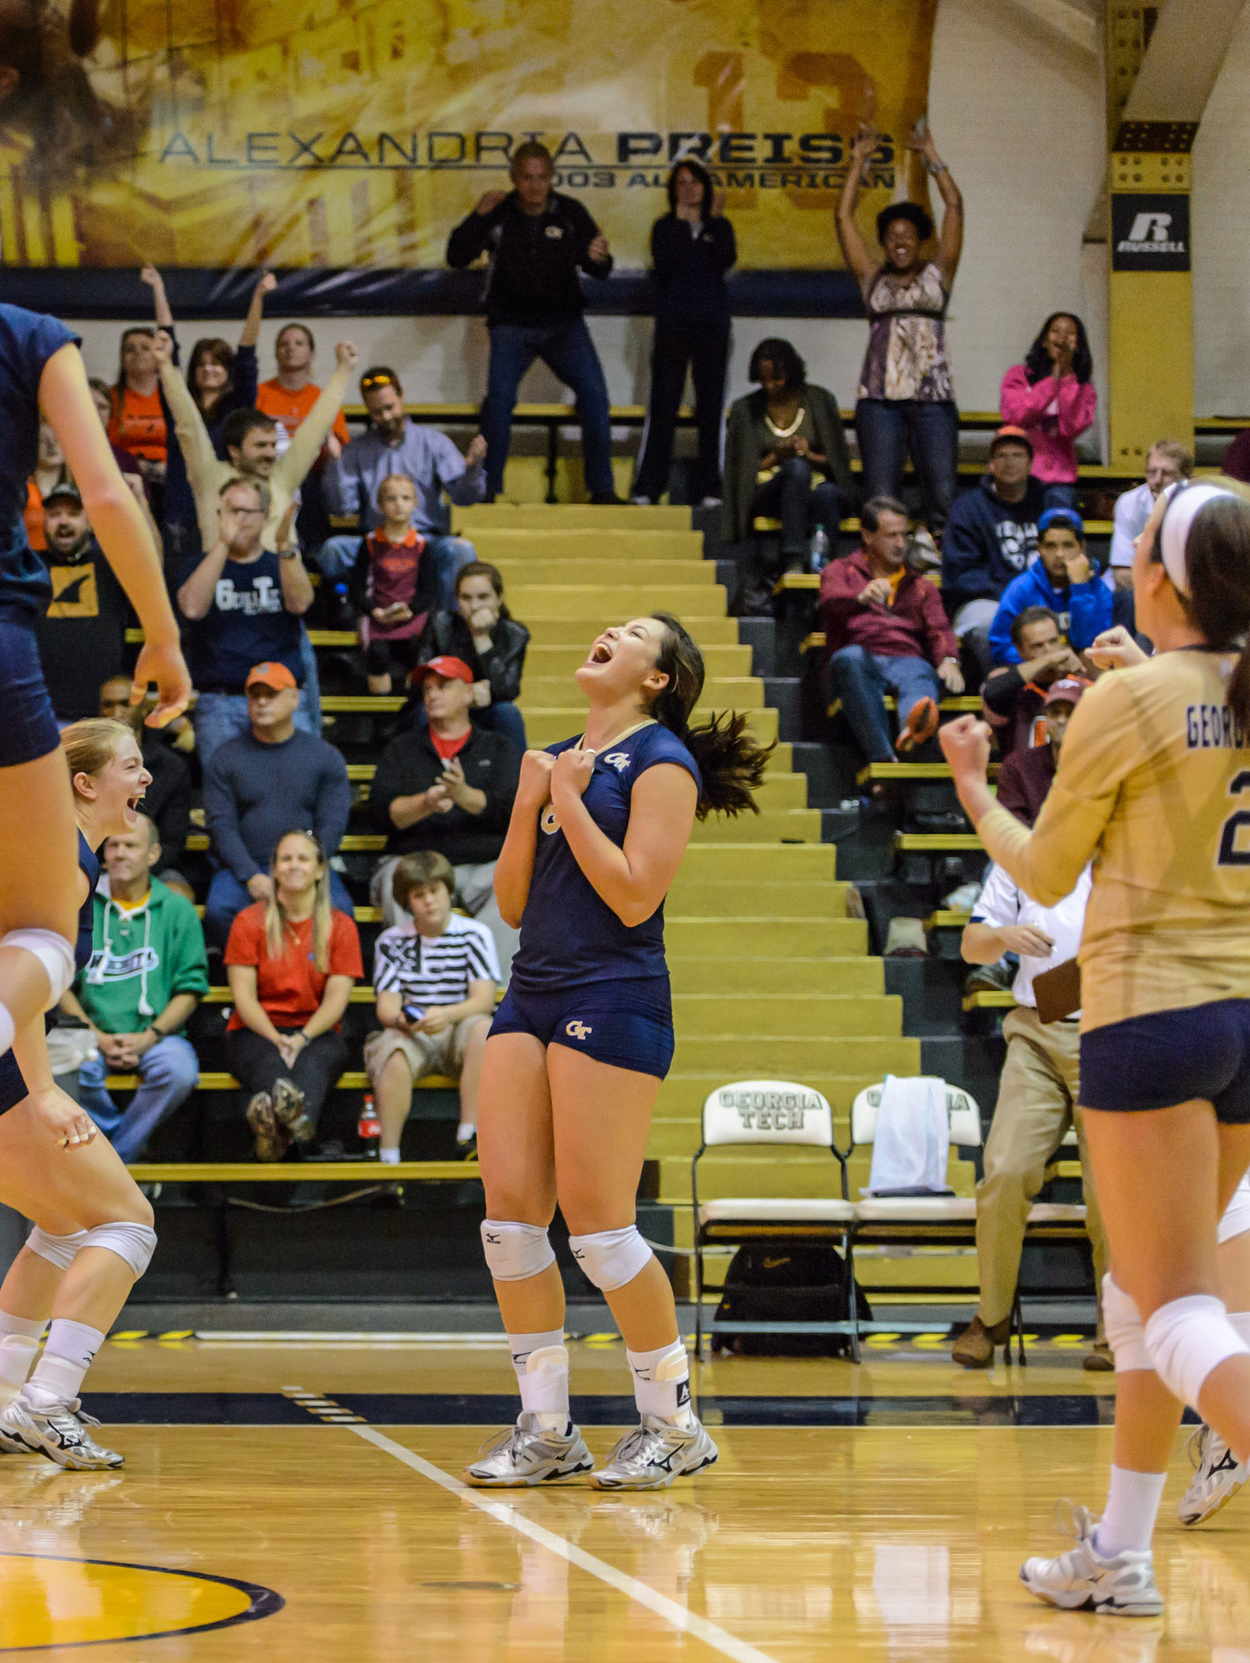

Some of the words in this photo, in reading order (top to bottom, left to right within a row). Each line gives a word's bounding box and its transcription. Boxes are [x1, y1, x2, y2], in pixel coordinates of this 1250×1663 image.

[1128, 212, 1173, 241] R
[565, 1020, 593, 1040] GT
[719, 1090, 823, 1110] GEORGIA
[739, 1109, 805, 1130] TECH
